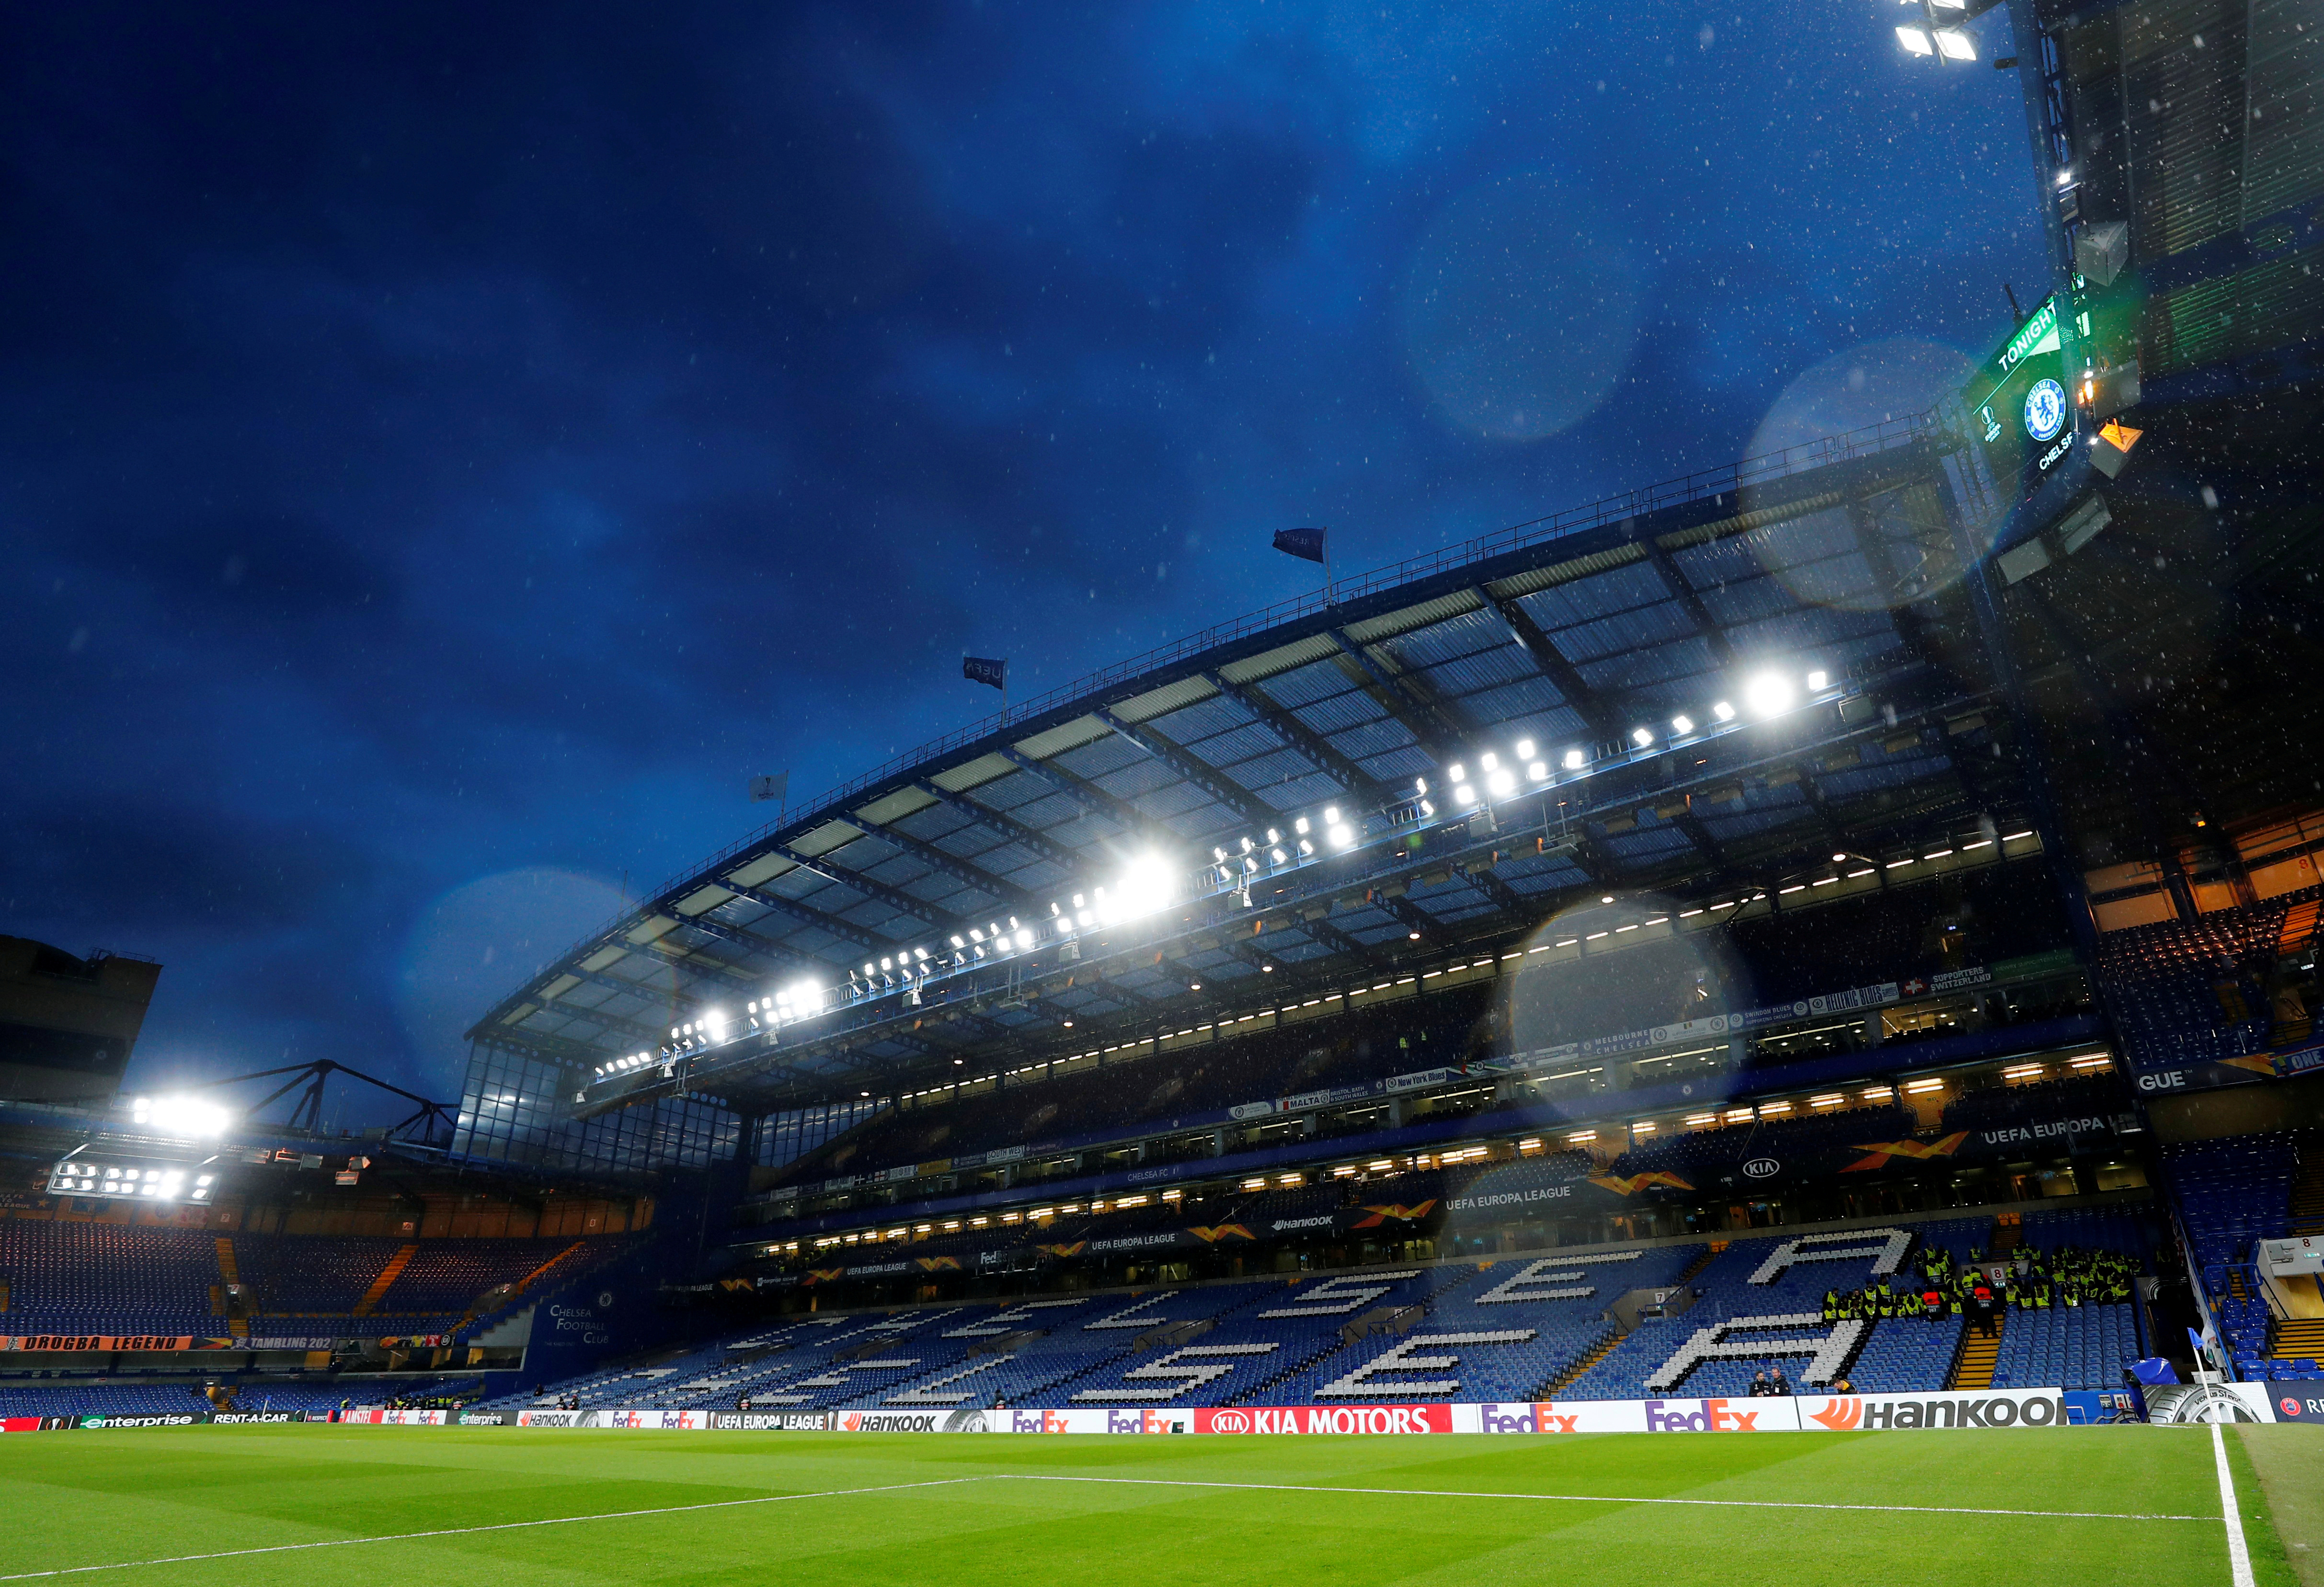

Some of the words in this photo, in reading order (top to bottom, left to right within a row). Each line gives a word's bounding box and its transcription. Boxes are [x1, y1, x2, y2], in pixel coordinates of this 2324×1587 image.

[1998, 301, 2056, 371] TONIGHT
[2027, 381, 2051, 408] CHELSEA
[2299, 858, 2308, 869] 8
[1930, 972, 1991, 991] SWITZERLAND
[1933, 966, 1984, 983] SUPPORTERS
[1825, 990, 1858, 1012] HELLENIC
[1859, 985, 1883, 1006] BLUES
[1745, 1008, 1771, 1018] SWINDON
[1773, 1005, 1791, 1013] BLUES
[1746, 1016, 1772, 1025] SUPPORTING
[1595, 1029, 1648, 1045] MELBOURNE
[1596, 1039, 1650, 1055] CHELSEA
[1397, 1078, 1411, 1087] New
[1412, 1073, 1428, 1084] York
[1428, 1072, 1445, 1082] Blues
[1352, 1090, 1369, 1098] WALES
[1290, 1096, 1320, 1108] MALTA
[1984, 1127, 2032, 1144] UEFA
[2033, 1117, 2106, 1138] EUROPA
[987, 1150, 1007, 1159] SOUTH
[1008, 1145, 1024, 1155] WEST
[1127, 1170, 1158, 1181] CHELSEA
[1159, 1168, 1168, 1177] FC
[1749, 1162, 1774, 1175] KIA
[1446, 1199, 1475, 1210] UEFA
[1477, 1192, 1523, 1207] EUROPA
[1524, 1186, 1571, 1201] LEAGUE
[1092, 1240, 1111, 1250] UEFA
[1112, 1237, 1143, 1248] EUROPA
[1144, 1233, 1176, 1245] LEAGUE
[2302, 1238, 2311, 1247] 8
[847, 1267, 861, 1275] UEFA
[861, 1264, 883, 1274] EUROPA
[884, 1262, 907, 1272] LEAGUE
[1994, 1269, 2001, 1278] 8
[696, 1283, 713, 1291] LEAGUE
[24, 1336, 101, 1350] DROGBA
[112, 1336, 178, 1350] LEGEND
[251, 1337, 308, 1348] TAMBLING
[308, 1337, 332, 1348] 202
[80, 1414, 193, 1429] enterprise
[213, 1413, 289, 1424] RENT-A-CAR
[345, 1410, 372, 1424] AMSTEL
[388, 1411, 407, 1425] FedEx
[418, 1411, 439, 1425] FedEx
[458, 1412, 503, 1426] enterprise
[612, 1411, 642, 1428] FedEx
[662, 1411, 695, 1429] FedEx
[717, 1415, 741, 1430] UEFA
[743, 1415, 781, 1430] EUROPA
[782, 1415, 824, 1430] LEAGUE
[1013, 1410, 1069, 1434] FedEx
[1108, 1410, 1172, 1434] FedEx
[1217, 1416, 1244, 1431] KIA
[1255, 1409, 1299, 1434] KIA
[1307, 1407, 1431, 1434] MOTORS
[1481, 1403, 1579, 1433] FedEx
[1645, 1399, 1759, 1432] FedEx
